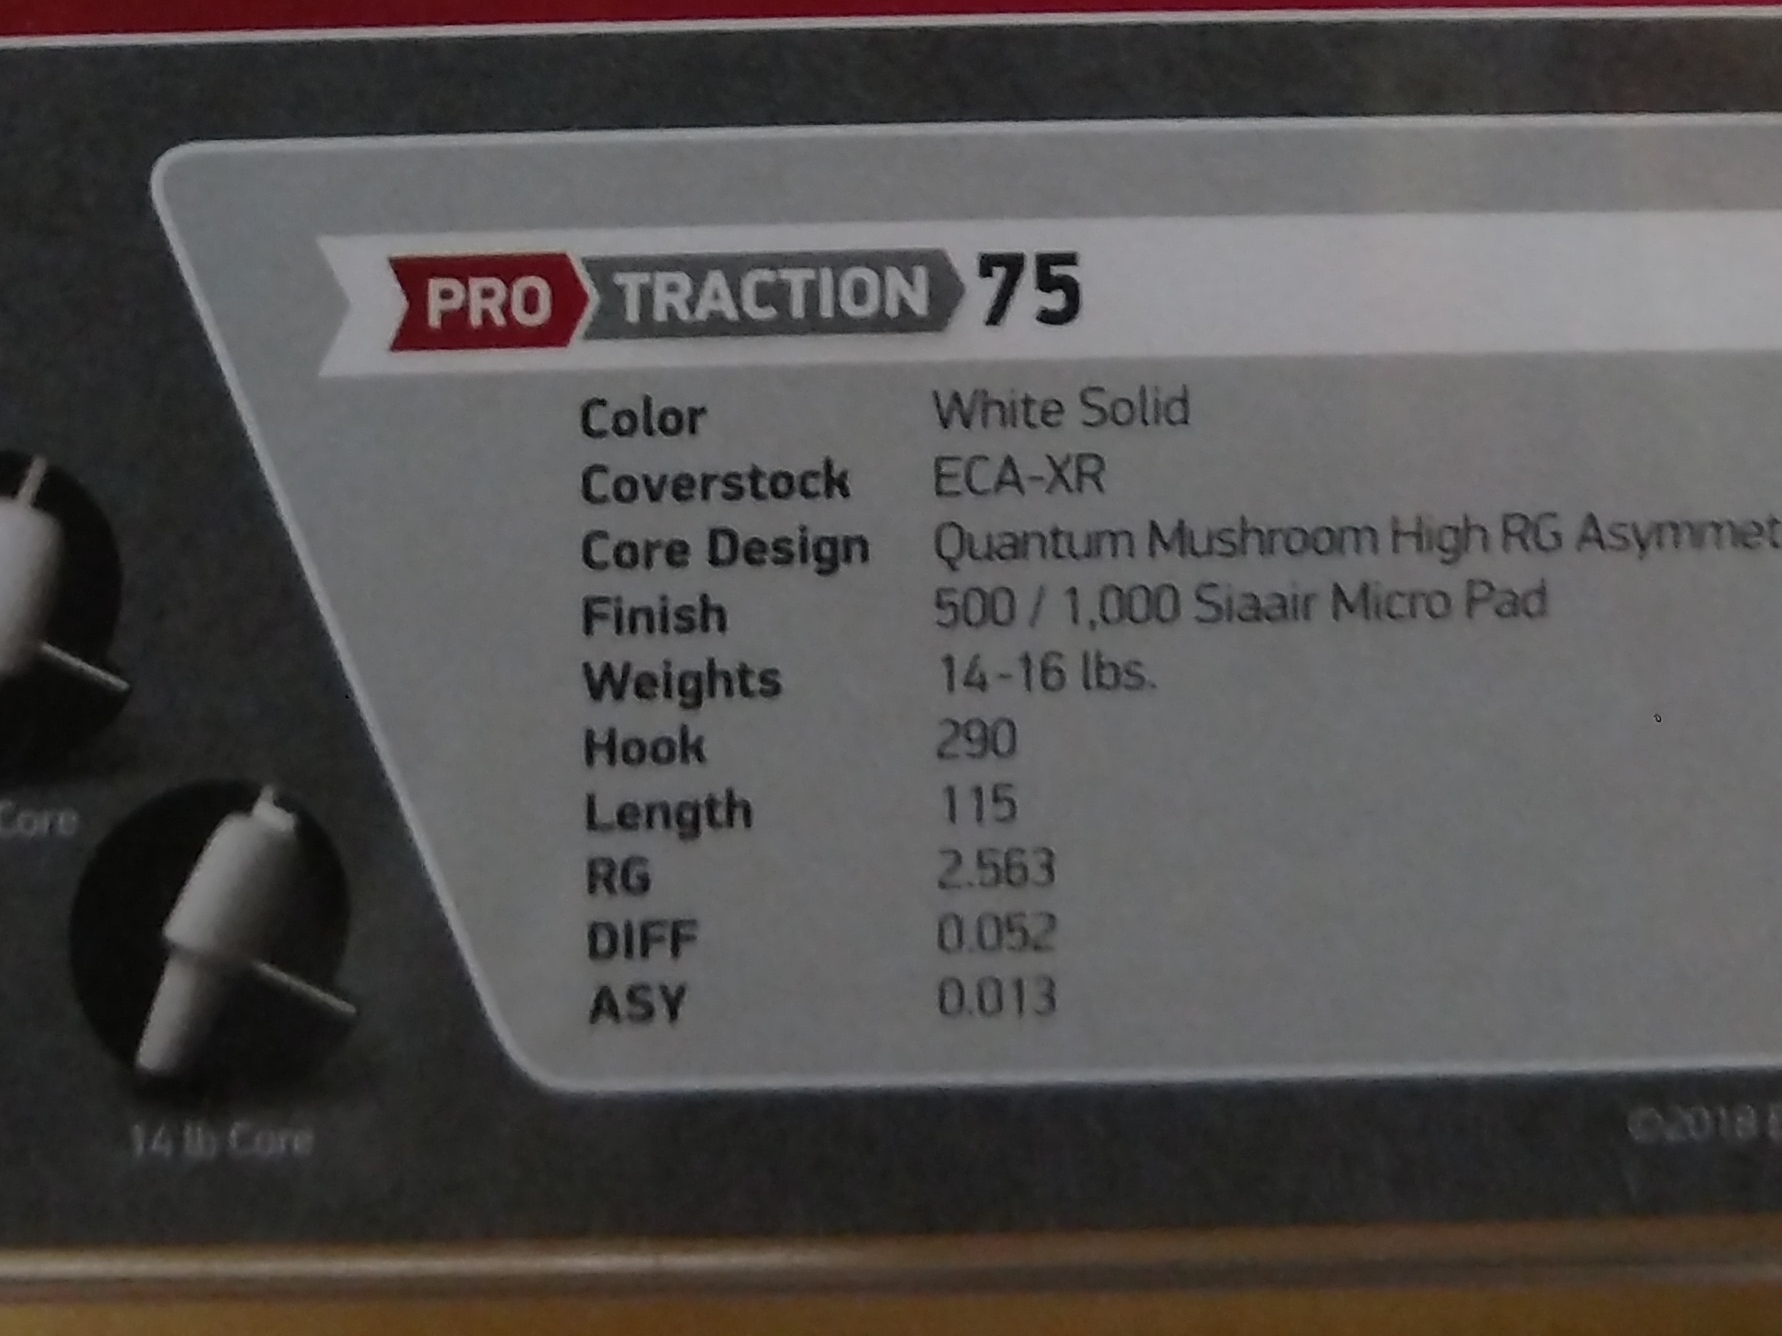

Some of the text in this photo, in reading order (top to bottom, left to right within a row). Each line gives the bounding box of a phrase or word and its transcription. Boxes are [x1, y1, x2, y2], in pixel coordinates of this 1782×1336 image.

[427, 252, 1081, 328] PRO TRACTION 75
[580, 383, 1191, 439] Color White Solid
[580, 452, 1106, 507] Coverstock ECA-XR
[580, 528, 690, 572] Core
[708, 524, 870, 575] Design
[934, 519, 1136, 567] Quantum
[1147, 516, 1378, 560] Mushroom
[1391, 514, 1489, 566] High
[1502, 511, 1563, 554] RG
[582, 593, 728, 638] Finish
[934, 585, 1016, 629] 500
[1066, 583, 1181, 633] 1,000
[1193, 579, 1317, 626] Siaair
[1330, 580, 1452, 623] Micro
[1465, 578, 1549, 621] Pad
[584, 650, 1158, 710] Weights 14-16 lbs.
[584, 718, 1017, 769] Hook 290
[586, 784, 1017, 840] Length 115
[586, 847, 1056, 896] RG 2.563
[587, 911, 1057, 960] DIFF 0.052
[588, 974, 1058, 1025] ASY 0.013
[131, 1122, 314, 1159] 14 lb Core
